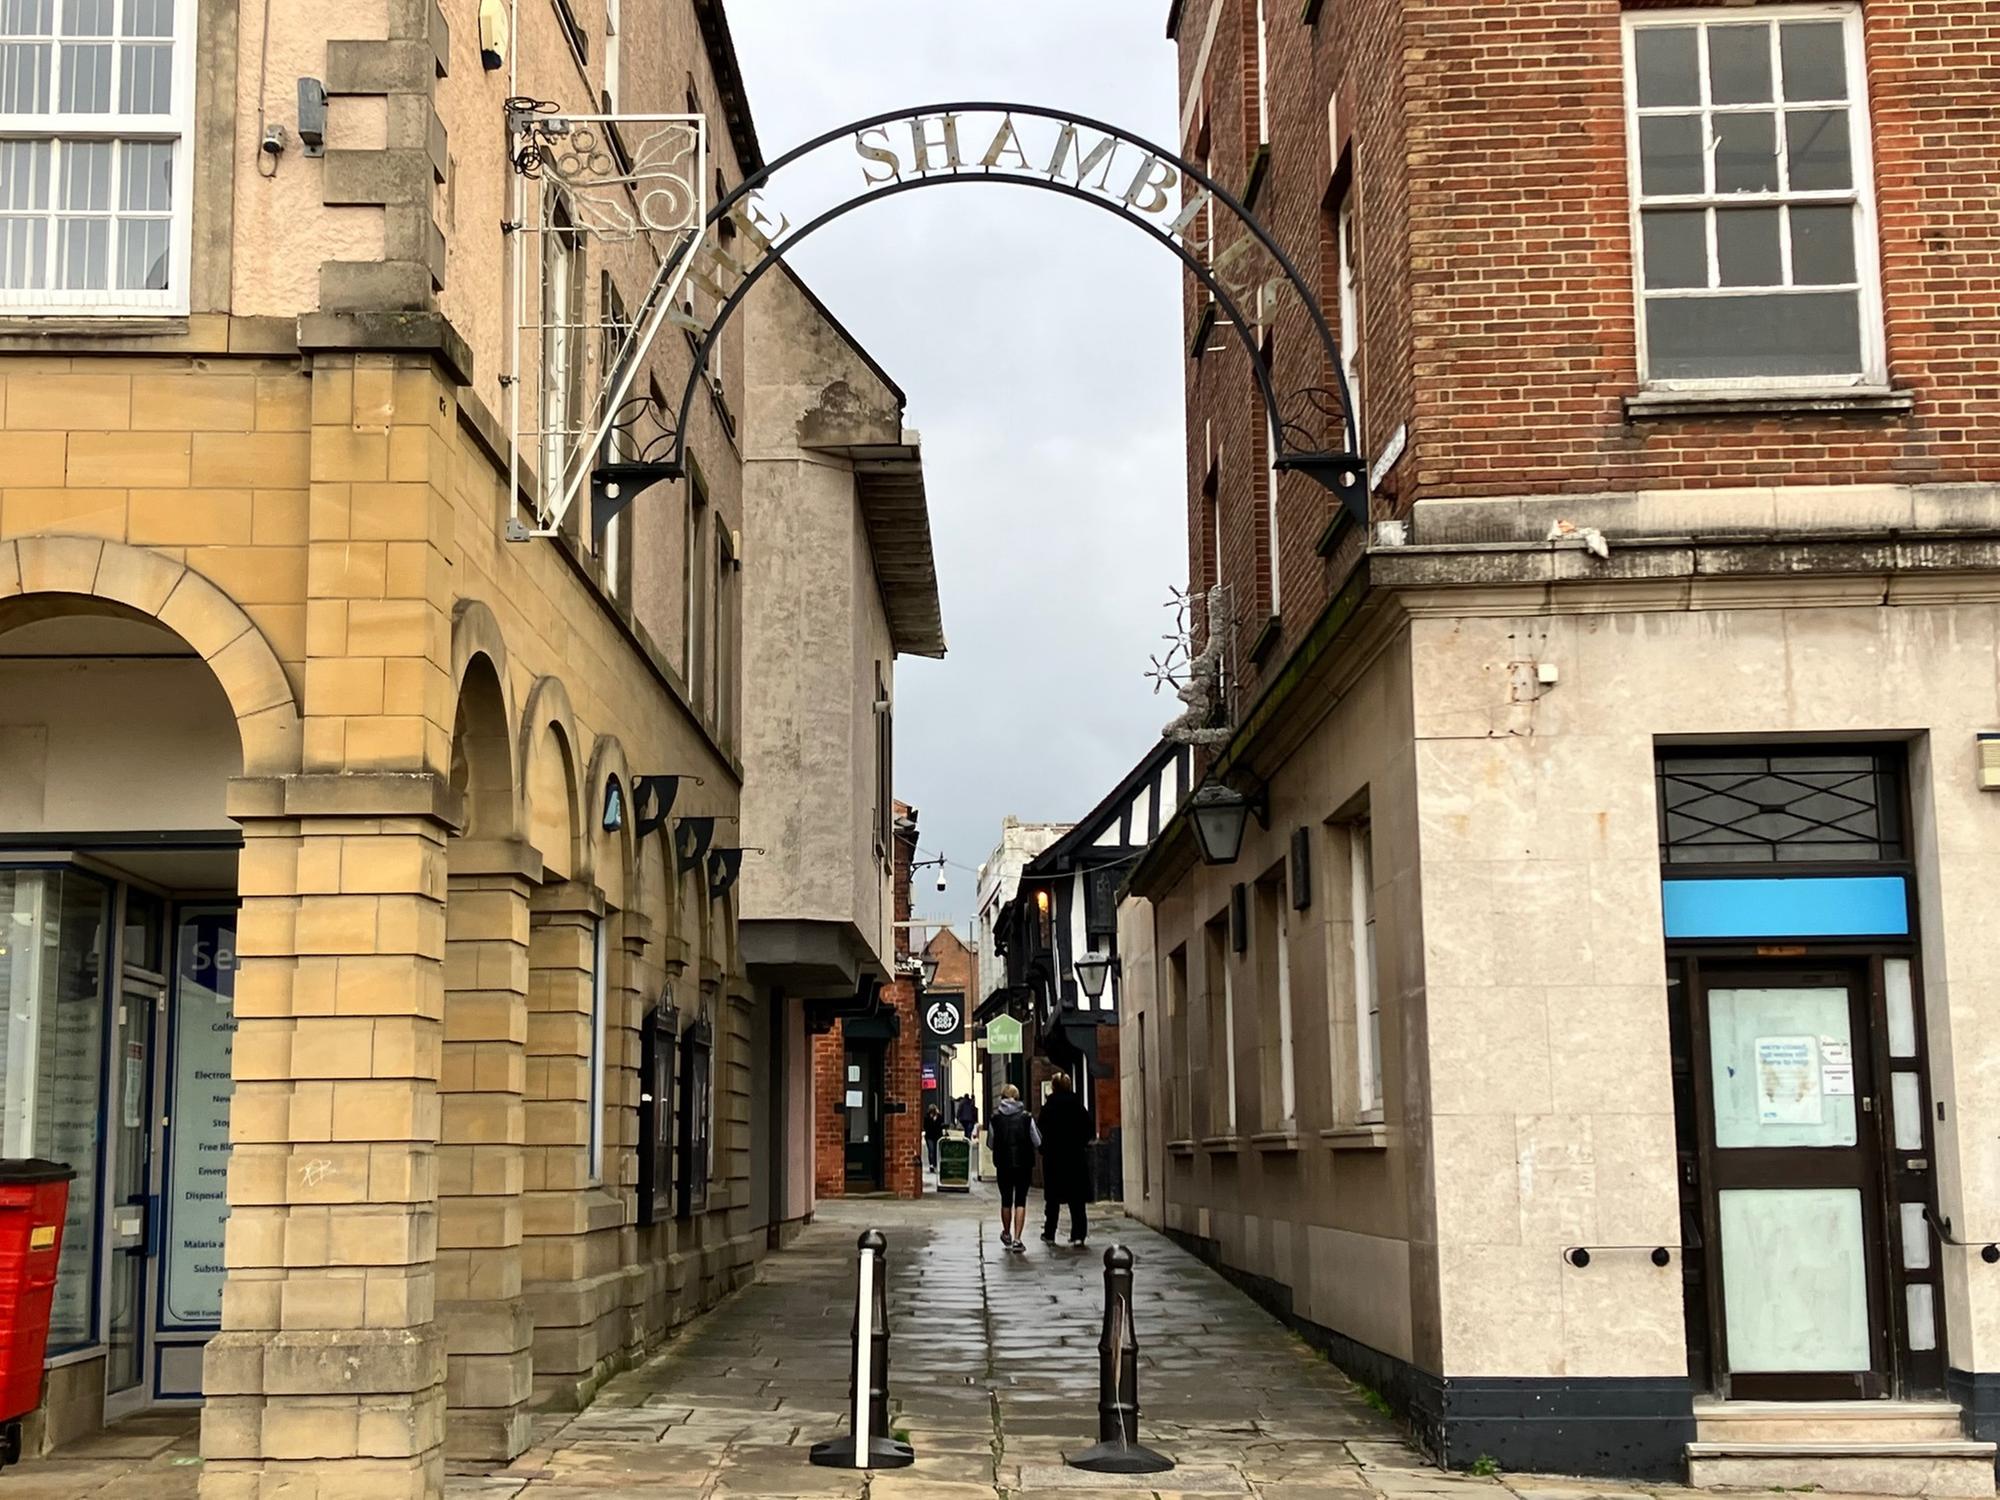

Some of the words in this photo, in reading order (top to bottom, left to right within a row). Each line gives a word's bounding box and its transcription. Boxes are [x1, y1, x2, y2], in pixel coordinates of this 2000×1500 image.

[855, 114, 1303, 327] SHAMBLES
[185, 1191, 223, 1202] Disposal
[184, 1241, 217, 1249] Malaria
